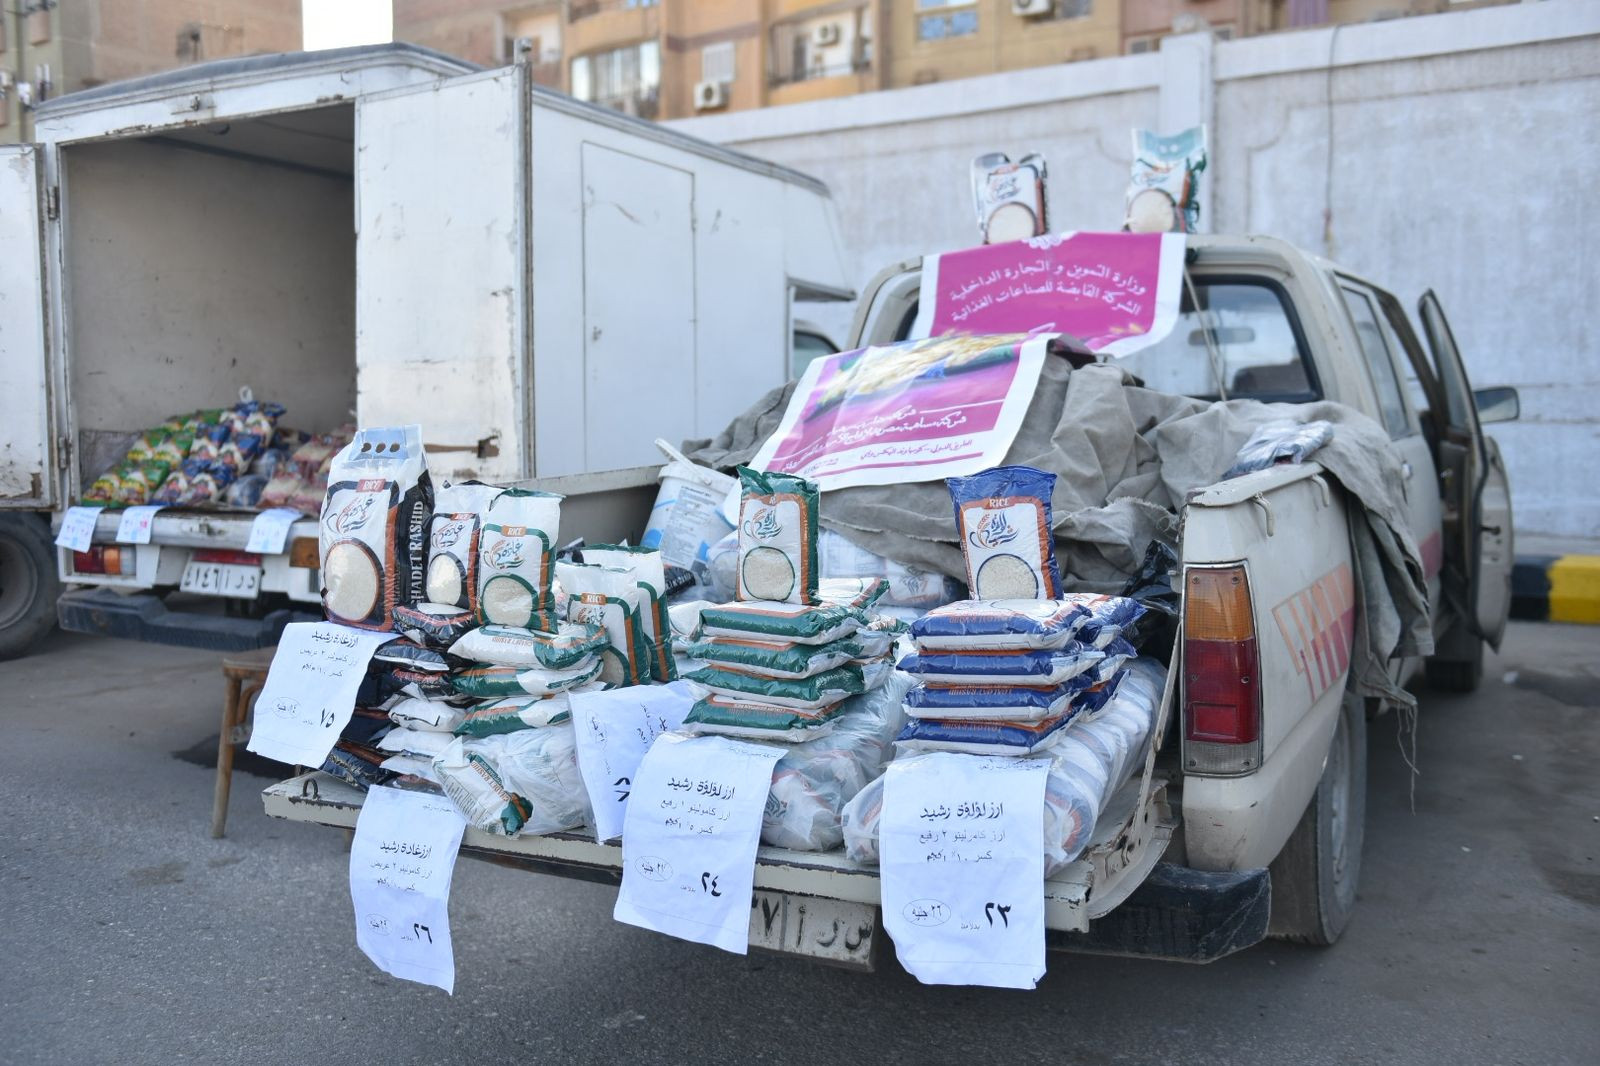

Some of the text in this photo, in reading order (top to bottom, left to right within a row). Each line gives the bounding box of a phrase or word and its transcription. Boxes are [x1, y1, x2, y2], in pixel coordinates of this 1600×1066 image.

[1004, 260, 1050, 280] التجارة
[1066, 264, 1110, 281] التموين
[950, 269, 1002, 301] الداخلية
[1112, 271, 1147, 296] وزارة
[953, 281, 1142, 322] الشركة القابضة للصناعات الغذائية
[990, 498, 1009, 508] RICE
[409, 501, 424, 551] RASHID
[320, 708, 336, 729] ٧٥
[667, 777, 693, 792] رشيد
[919, 803, 952, 822] رشيد
[380, 840, 400, 854] رشيد
[974, 850, 993, 863] كسر
[701, 871, 722, 897] ٢٤
[984, 902, 1012, 929] ٢٣
[413, 922, 434, 945] ٢٦
